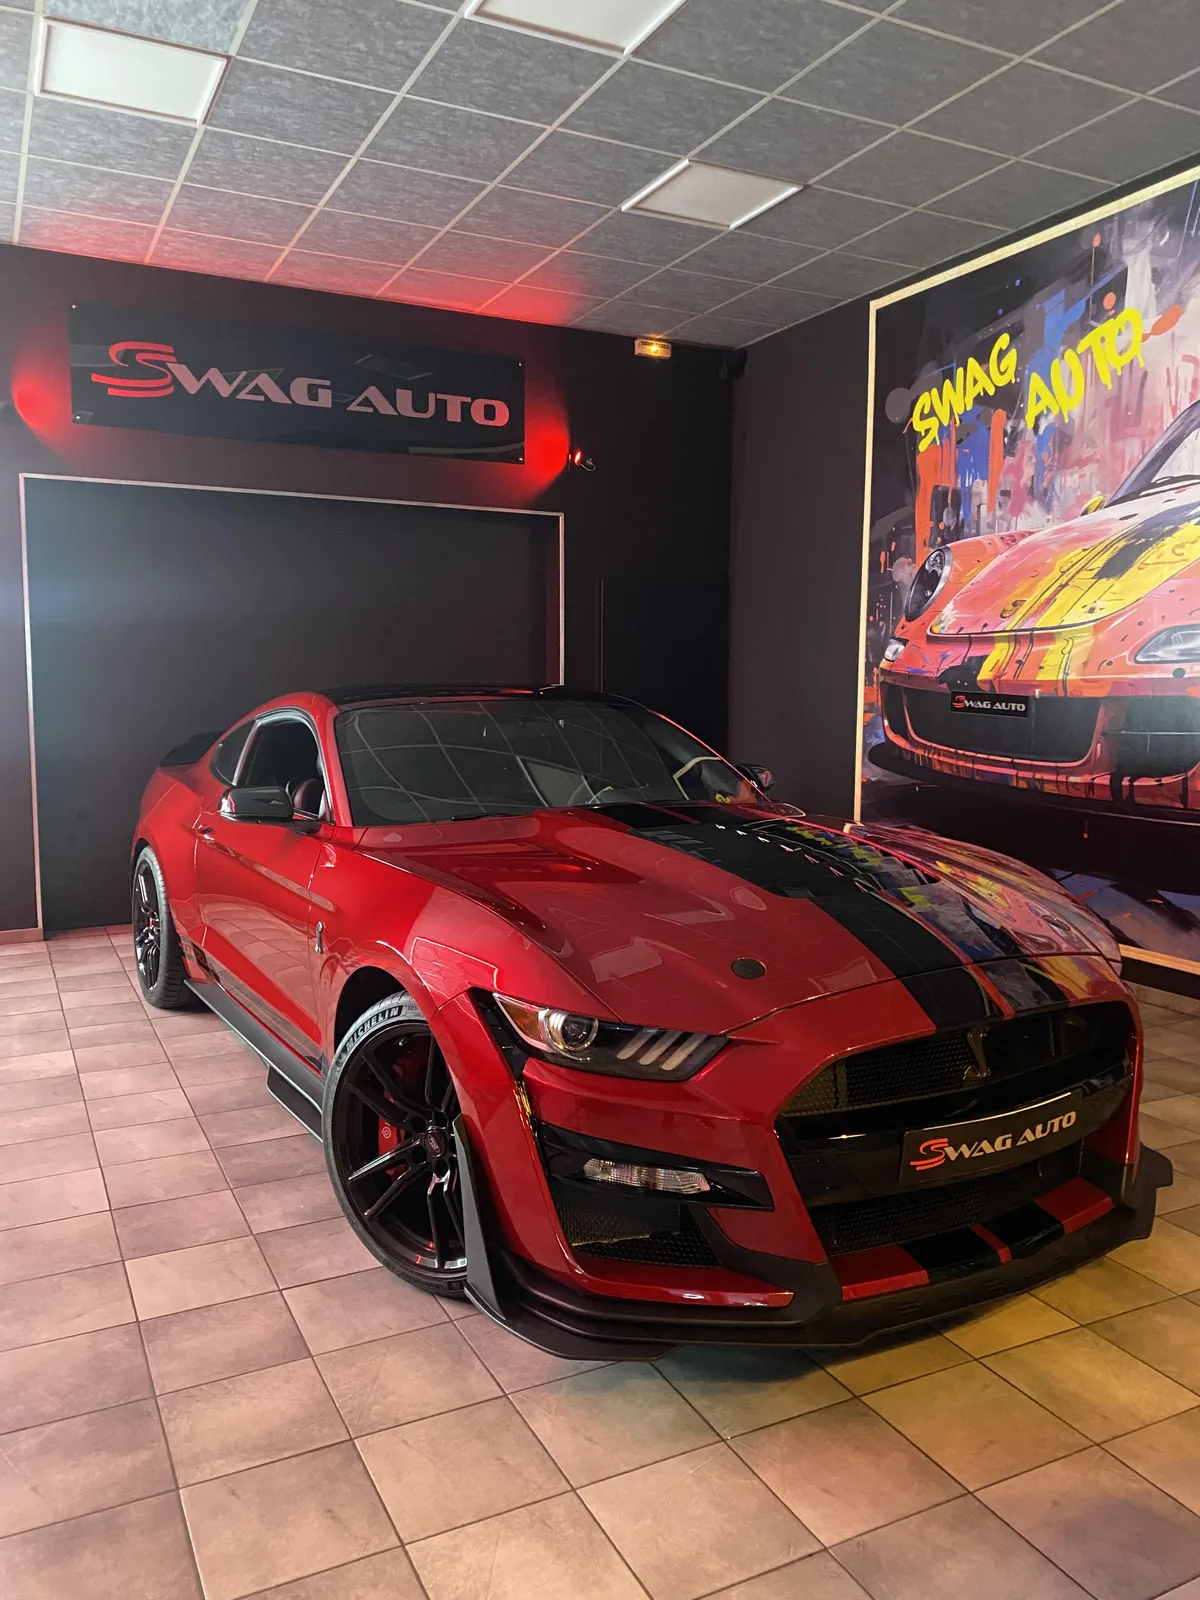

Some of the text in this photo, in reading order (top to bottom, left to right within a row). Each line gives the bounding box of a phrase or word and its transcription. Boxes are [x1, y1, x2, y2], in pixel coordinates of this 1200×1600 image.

[91, 341, 510, 427] SWAG AUTO
[912, 307, 1144, 452] SWAG AUTO
[952, 695, 1026, 711] SWAG AUTO
[345, 1006, 399, 1051] MICHELIN
[910, 1111, 1076, 1171] SWAG AUTO
